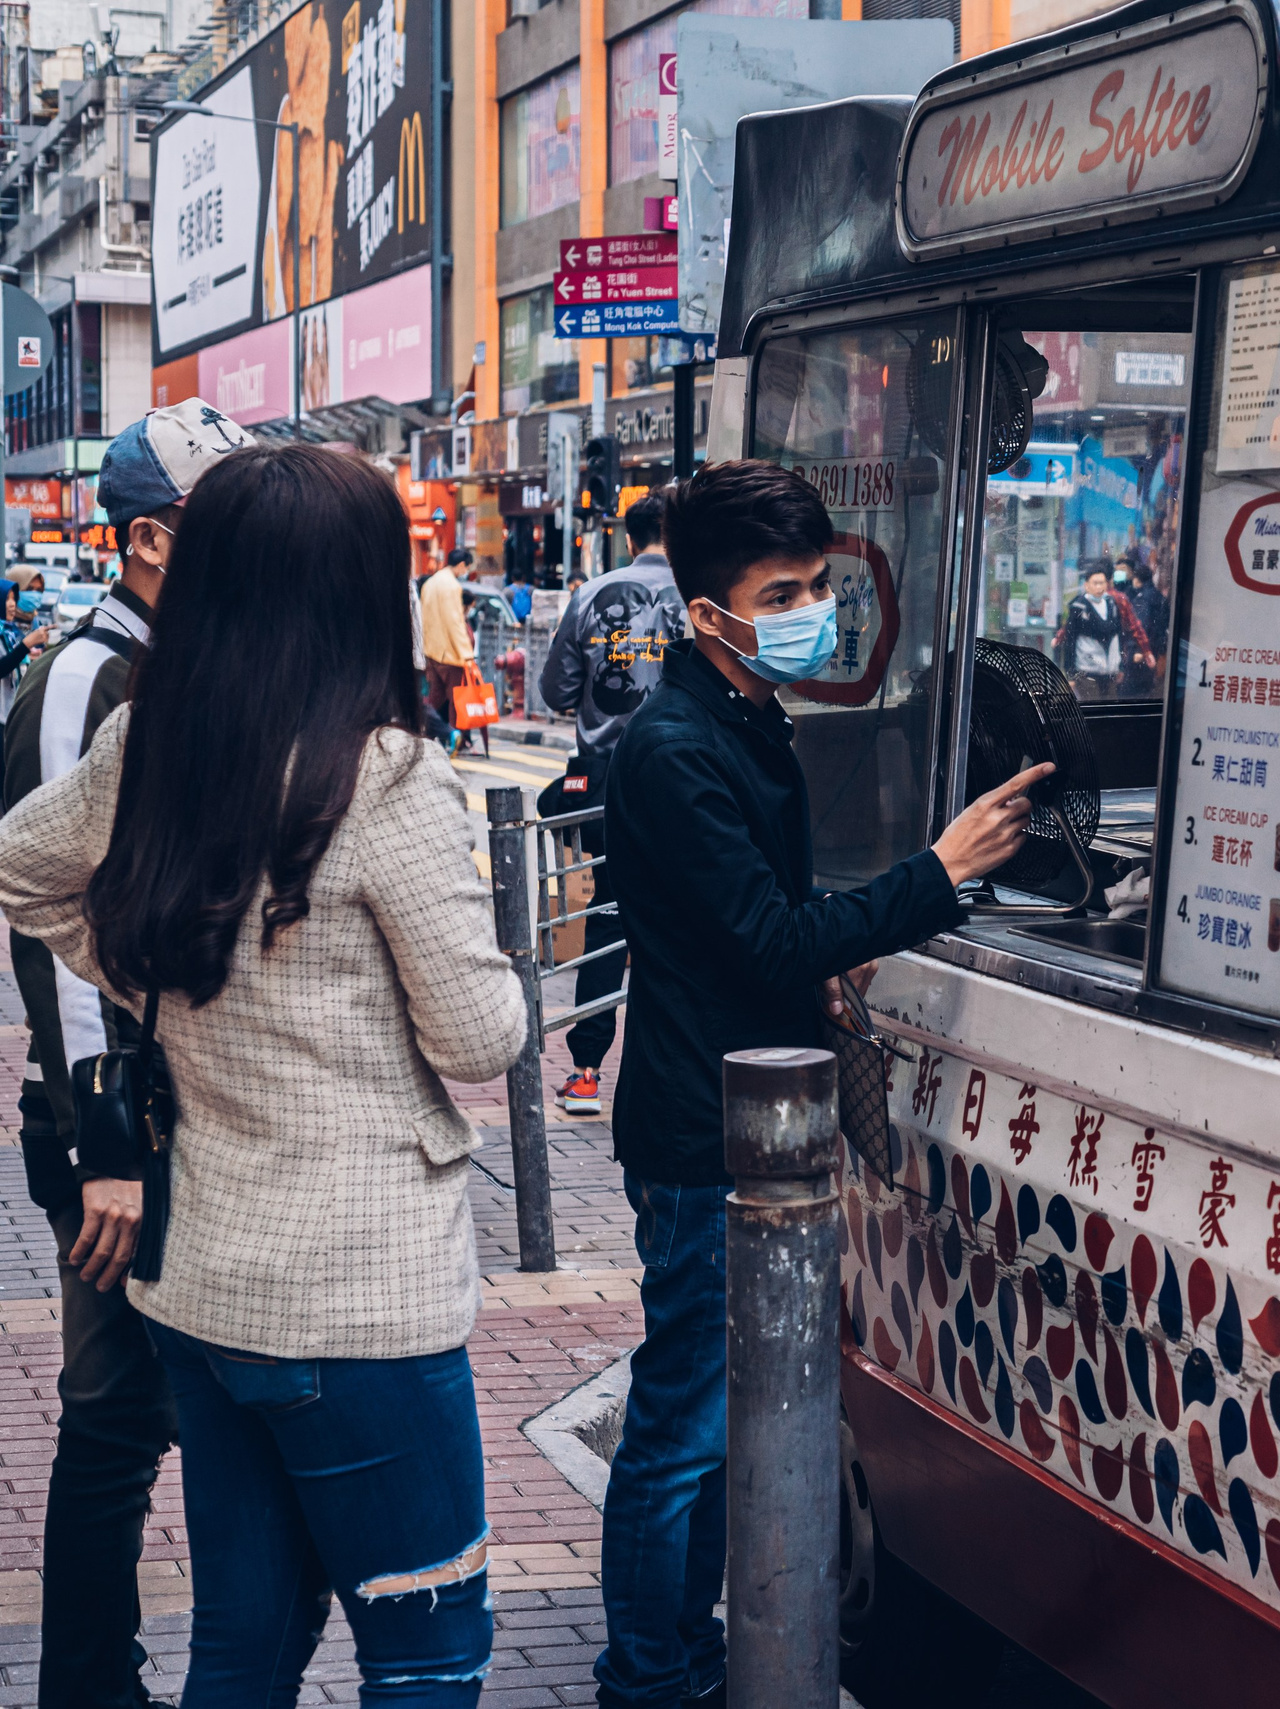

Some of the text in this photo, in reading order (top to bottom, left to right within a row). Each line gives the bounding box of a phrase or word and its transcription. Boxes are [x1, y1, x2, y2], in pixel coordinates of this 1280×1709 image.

[664, 113, 677, 158] Mong
[938, 65, 1212, 207] Mobile Softee
[608, 256, 623, 266] Tung
[624, 254, 637, 265] Choi
[638, 254, 655, 264] Street
[607, 273, 637, 286] 花園街
[607, 286, 673, 298] Fa Yuen Street
[604, 320, 678, 333] Mong Kok Compute
[615, 411, 642, 445] Bank
[838, 574, 874, 620] Softee
[1215, 647, 1237, 662] SOFT
[1239, 648, 1252, 663] ICE
[1199, 659, 1211, 688] 1.
[1207, 726, 1280, 748] NUTTY DRUMSTICK
[1191, 738, 1205, 766] 2.
[1212, 755, 1268, 787] 果仁甜筒
[1203, 805, 1268, 828] ICE CREAM CUP
[1184, 816, 1198, 845] 3.
[1211, 835, 1254, 867] 蓮花杯
[1195, 884, 1262, 911] JUMBO ORANGE
[1177, 895, 1190, 923] 4.
[1197, 913, 1251, 950] 珍寶橙冰
